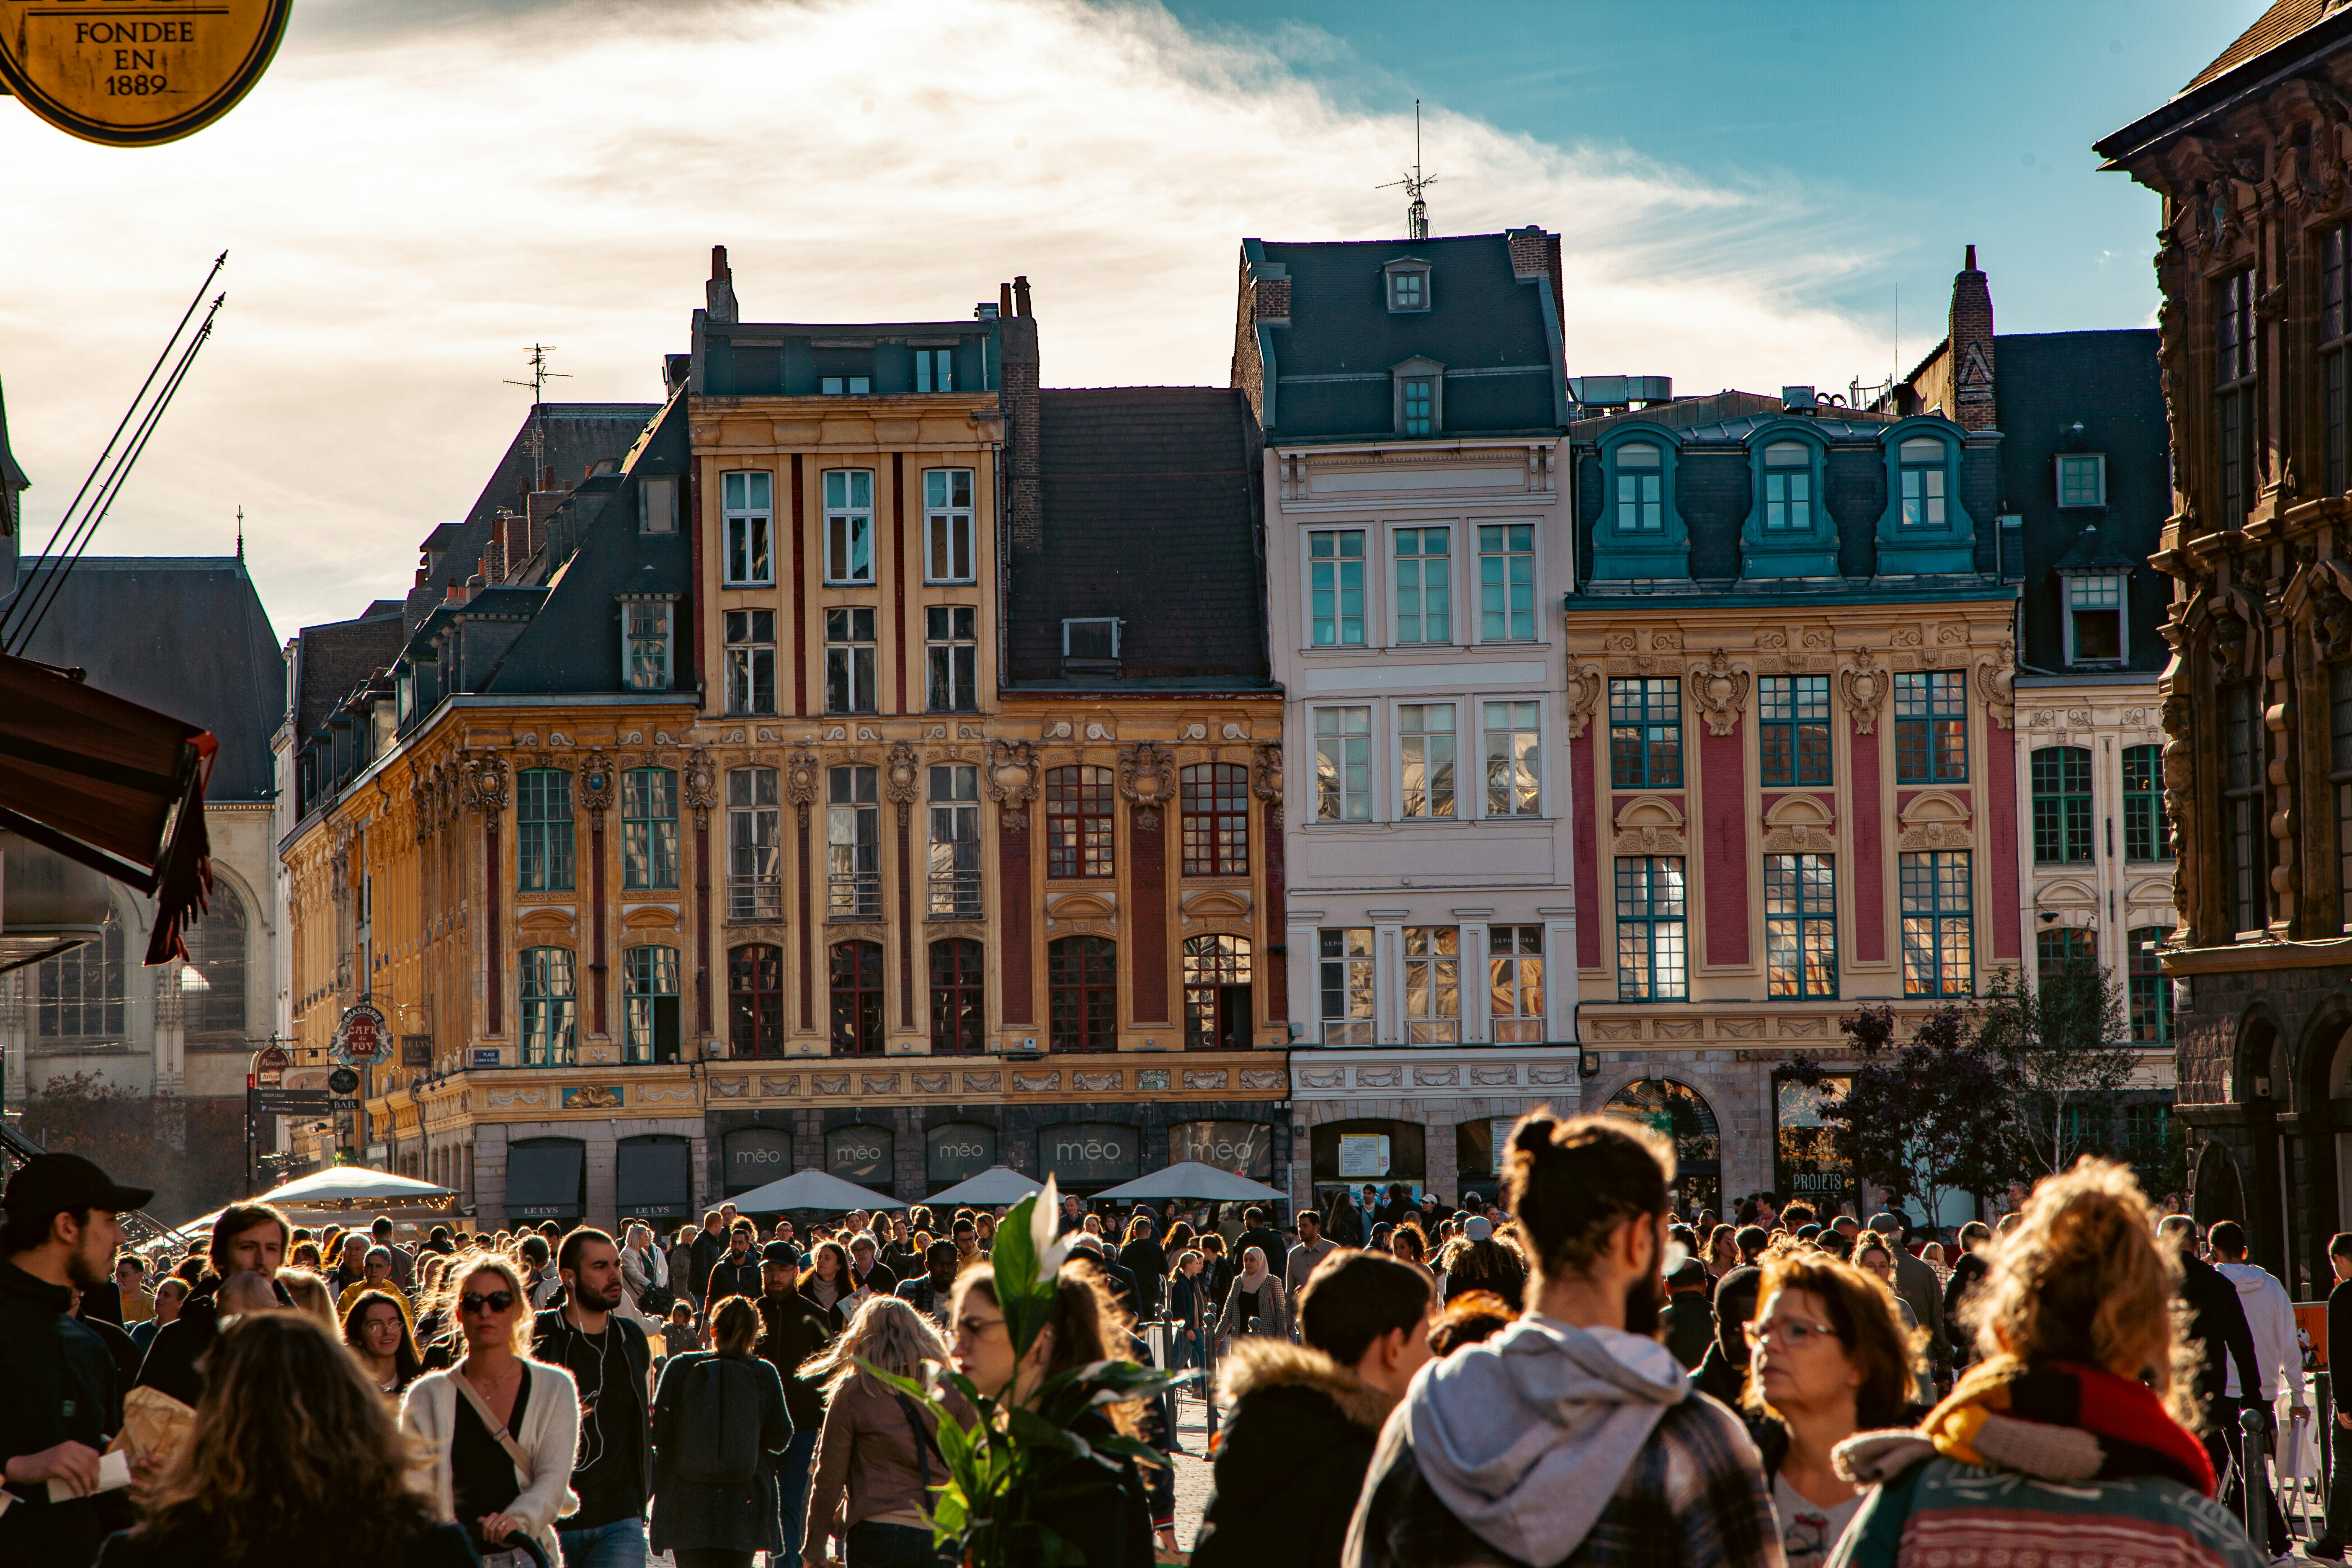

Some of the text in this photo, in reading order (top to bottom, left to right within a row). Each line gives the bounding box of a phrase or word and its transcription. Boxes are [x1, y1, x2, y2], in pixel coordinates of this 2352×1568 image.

[75, 22, 193, 44] FONDEE
[113, 49, 155, 70] EN
[106, 75, 167, 95] 1889
[344, 1007, 382, 1023] BRASSERIE
[352, 1042, 373, 1050] FOY
[1736, 1047, 1895, 1062] BNP PARIBS
[1794, 1174, 1841, 1190] PROJETS
